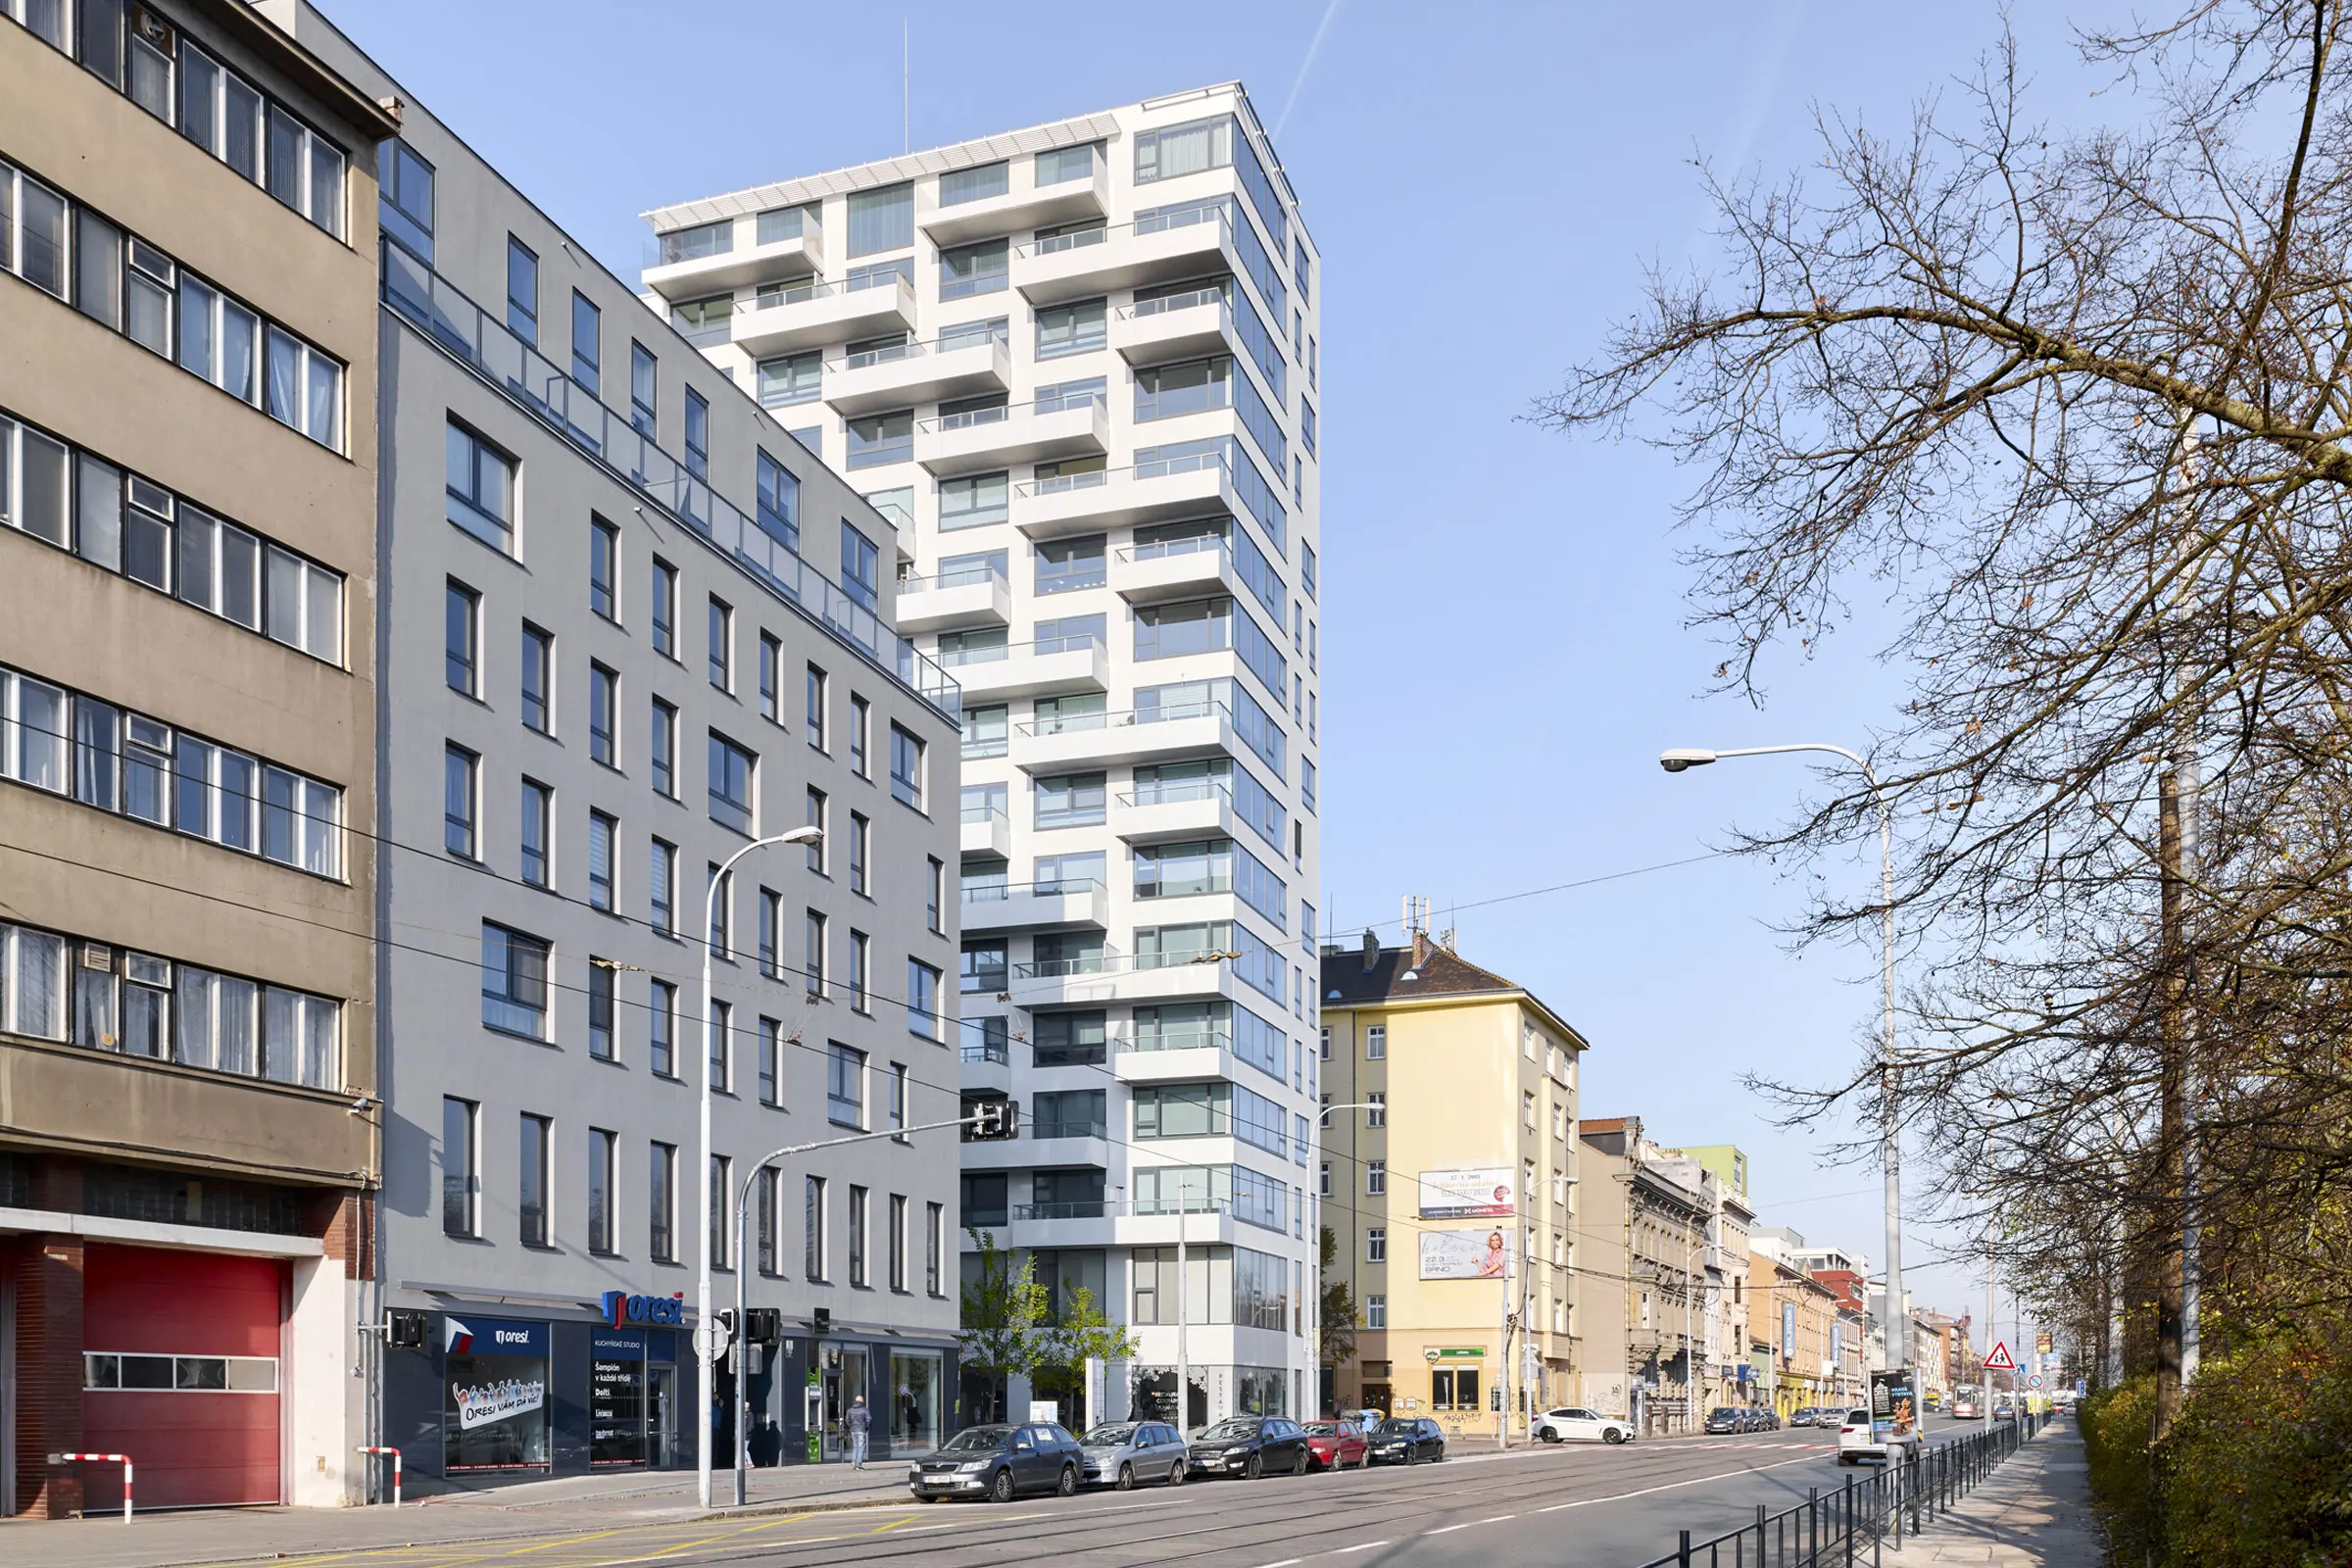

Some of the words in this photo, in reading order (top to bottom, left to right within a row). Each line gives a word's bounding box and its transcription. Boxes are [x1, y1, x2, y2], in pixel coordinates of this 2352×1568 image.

[627, 1291, 683, 1325] oresi
[505, 1330, 529, 1344] oresi
[466, 1405, 496, 1421] ORESI
[497, 1398, 515, 1412] VÁM
[516, 1396, 527, 1407] DÁ
